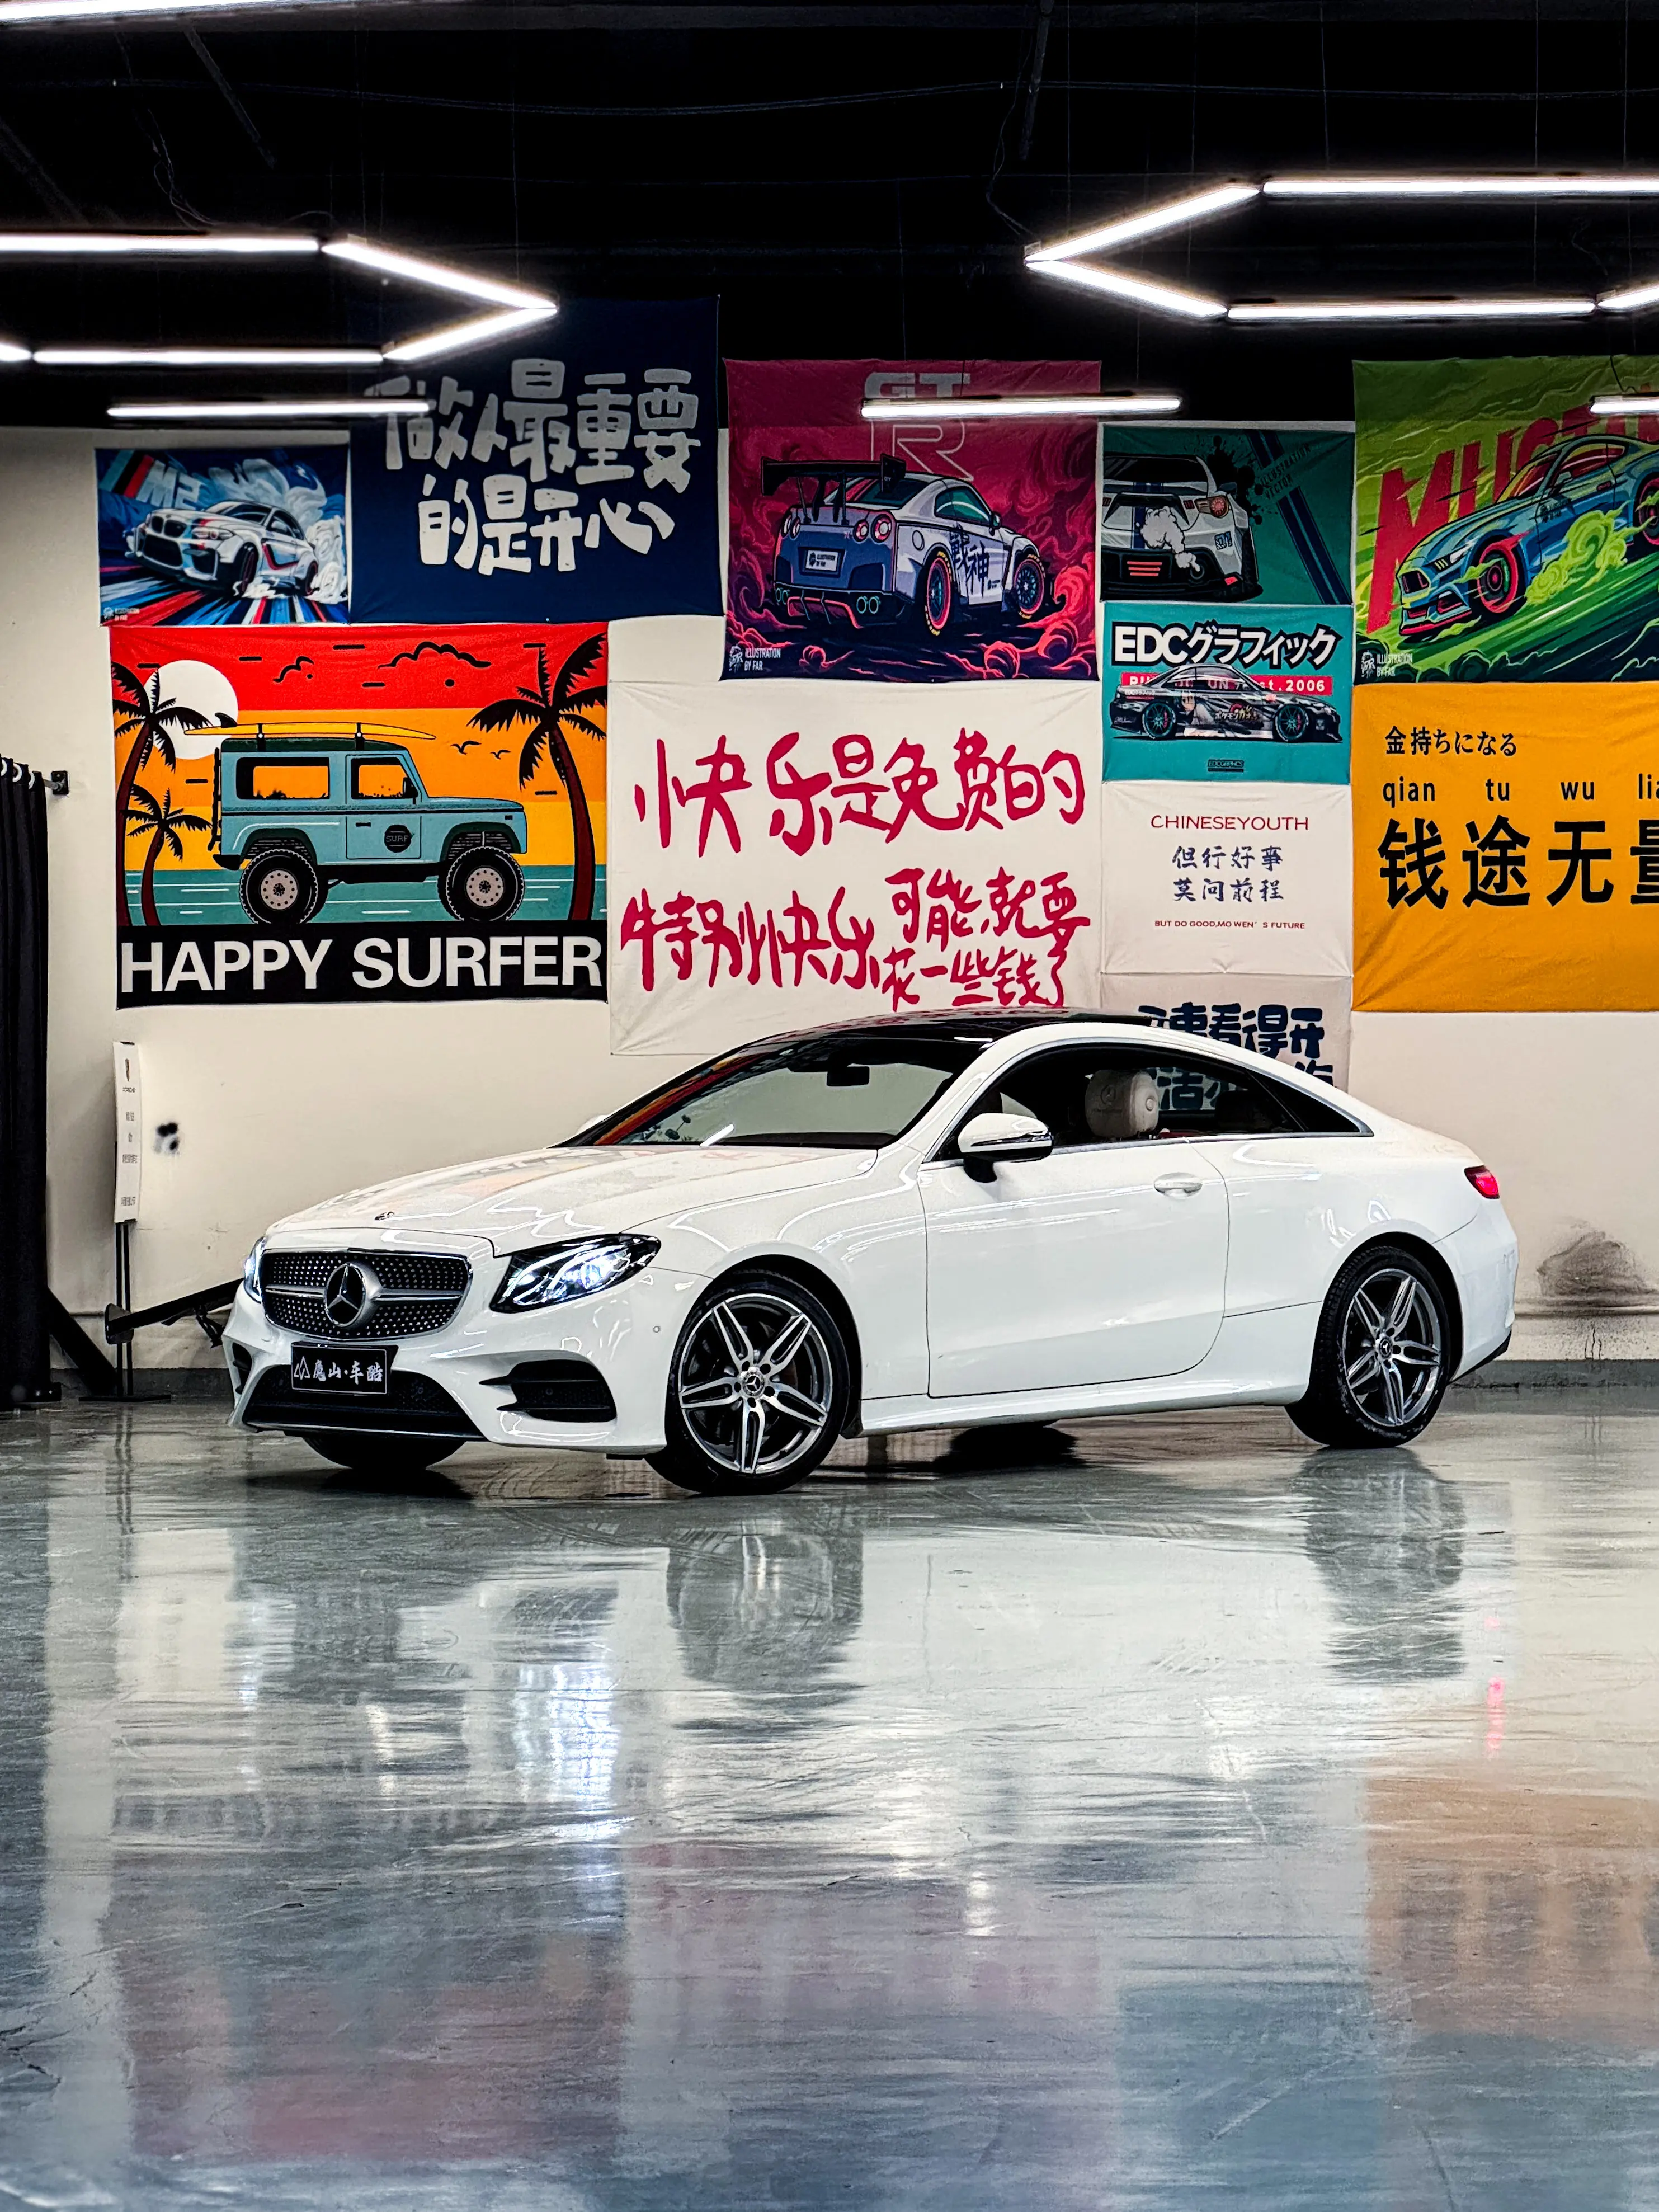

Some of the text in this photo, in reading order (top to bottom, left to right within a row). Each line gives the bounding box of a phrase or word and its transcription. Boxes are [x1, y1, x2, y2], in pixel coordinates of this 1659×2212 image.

[418, 474, 675, 576] 的是开心
[744, 648, 781, 658] ILLUSTRATION
[1114, 625, 1337, 666] EDCグラフィック
[1377, 653, 1413, 665] ILLUSTRATION
[744, 661, 763, 671] BY FAR
[1384, 726, 1517, 756] 金持ちになる
[1383, 773, 1659, 808] qian tu wu li
[1151, 815, 1309, 830] CHINESEYOUTH
[1172, 845, 1283, 872] 但行好事
[1173, 877, 1284, 902] 莫问前程
[121, 936, 602, 993] HAPPY SURFER
